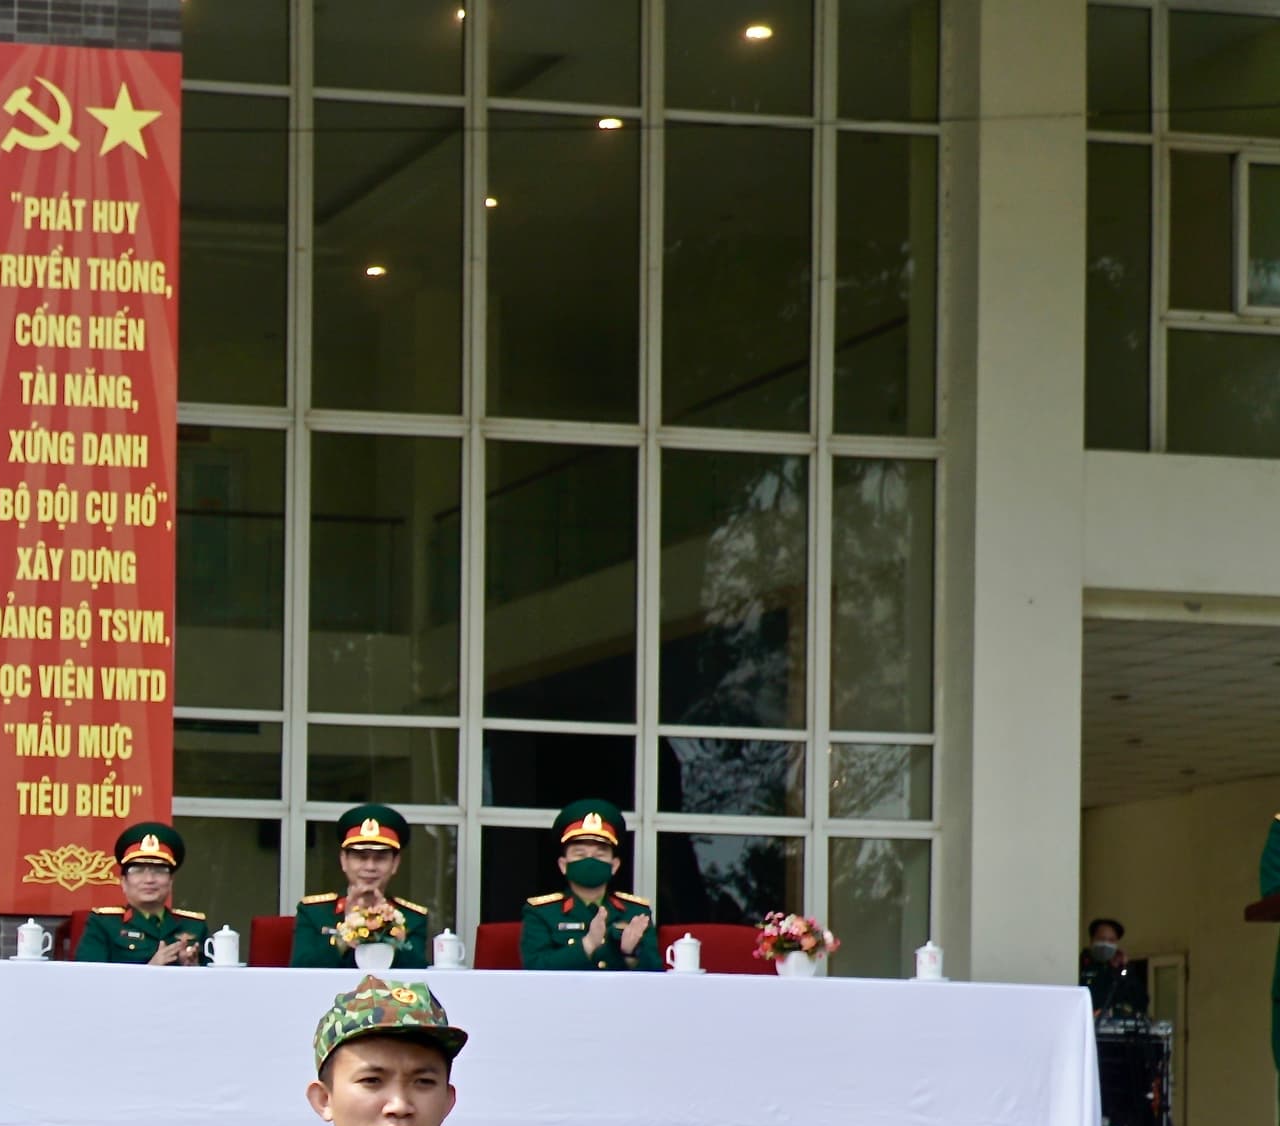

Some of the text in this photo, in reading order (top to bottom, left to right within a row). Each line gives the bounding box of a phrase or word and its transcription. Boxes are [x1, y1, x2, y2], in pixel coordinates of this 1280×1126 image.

[11, 191, 139, 234] "PHÁT HUY
[87, 248, 172, 299] THỐNG,
[15, 302, 145, 351] CỐNG HIẾN
[20, 365, 139, 413] TÀI NĂNG,
[9, 421, 148, 468] XỨNG DANH
[37, 483, 77, 530] ĐỘI
[86, 491, 118, 532] CỤ
[16, 541, 137, 589] XÂY DỰNG
[60, 601, 91, 649] BỘ
[99, 608, 170, 648] TSVM,
[39, 659, 94, 706] VIỆN
[101, 667, 166, 703] VMTD
[4, 712, 133, 766] "MẪU MỰC
[17, 771, 142, 818] TIÊU BIỂU"
